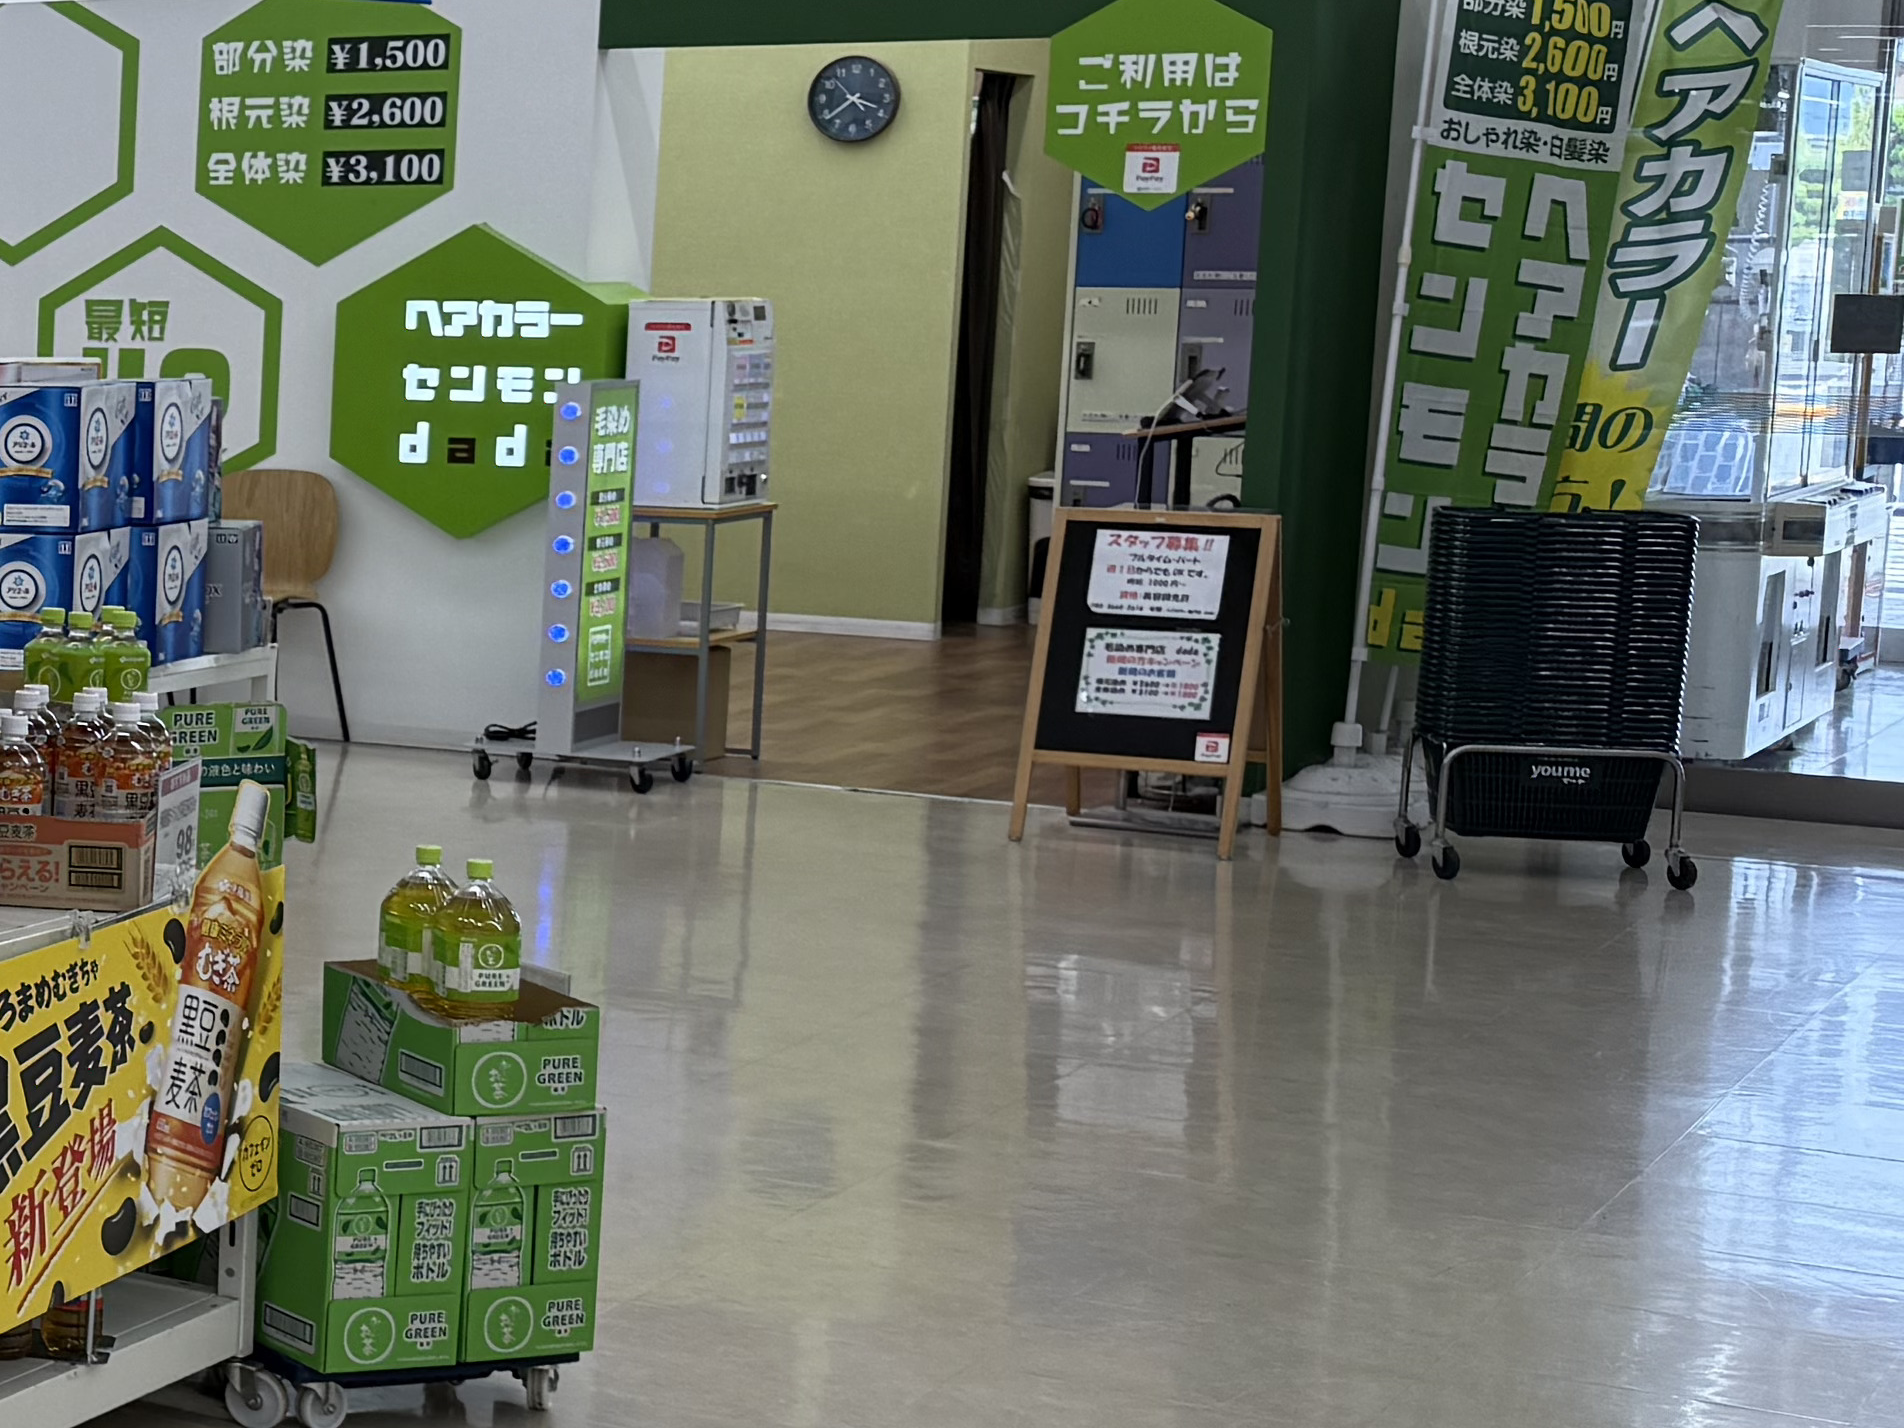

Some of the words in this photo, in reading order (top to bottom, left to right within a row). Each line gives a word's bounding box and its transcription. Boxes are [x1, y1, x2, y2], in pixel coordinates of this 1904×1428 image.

[213, 39, 312, 76] 部分染
[330, 38, 447, 69] ¥1,500
[1079, 52, 1242, 90] ご利用は
[1459, 30, 1519, 63] 根元染
[1523, 33, 1618, 82] 2,600円
[209, 95, 310, 130] 根元染
[327, 93, 444, 128] ¥2,600
[1056, 99, 1260, 135] コチラから
[1451, 74, 1514, 106] 全体染
[1517, 75, 1612, 125] 3,100円
[1440, 118, 1611, 165] おしゃれ染・白髪染
[207, 151, 308, 186] 全体染
[325, 152, 440, 184] ¥3,100
[84, 298, 170, 342] 最短
[405, 300, 583, 339] ヘアカラー
[594, 405, 630, 436] 毛染め
[592, 442, 629, 474] 専門店
[174, 712, 214, 727] PURE
[1530, 762, 1592, 780] youme
[195, 942, 242, 992] むぎ茶
[536, 1070, 584, 1085] GREEN
[541, 1056, 580, 1071] PURE
[3, 1097, 117, 1293] 新登場
[404, 1325, 447, 1340] GREEN
[410, 1312, 444, 1325] PURE
